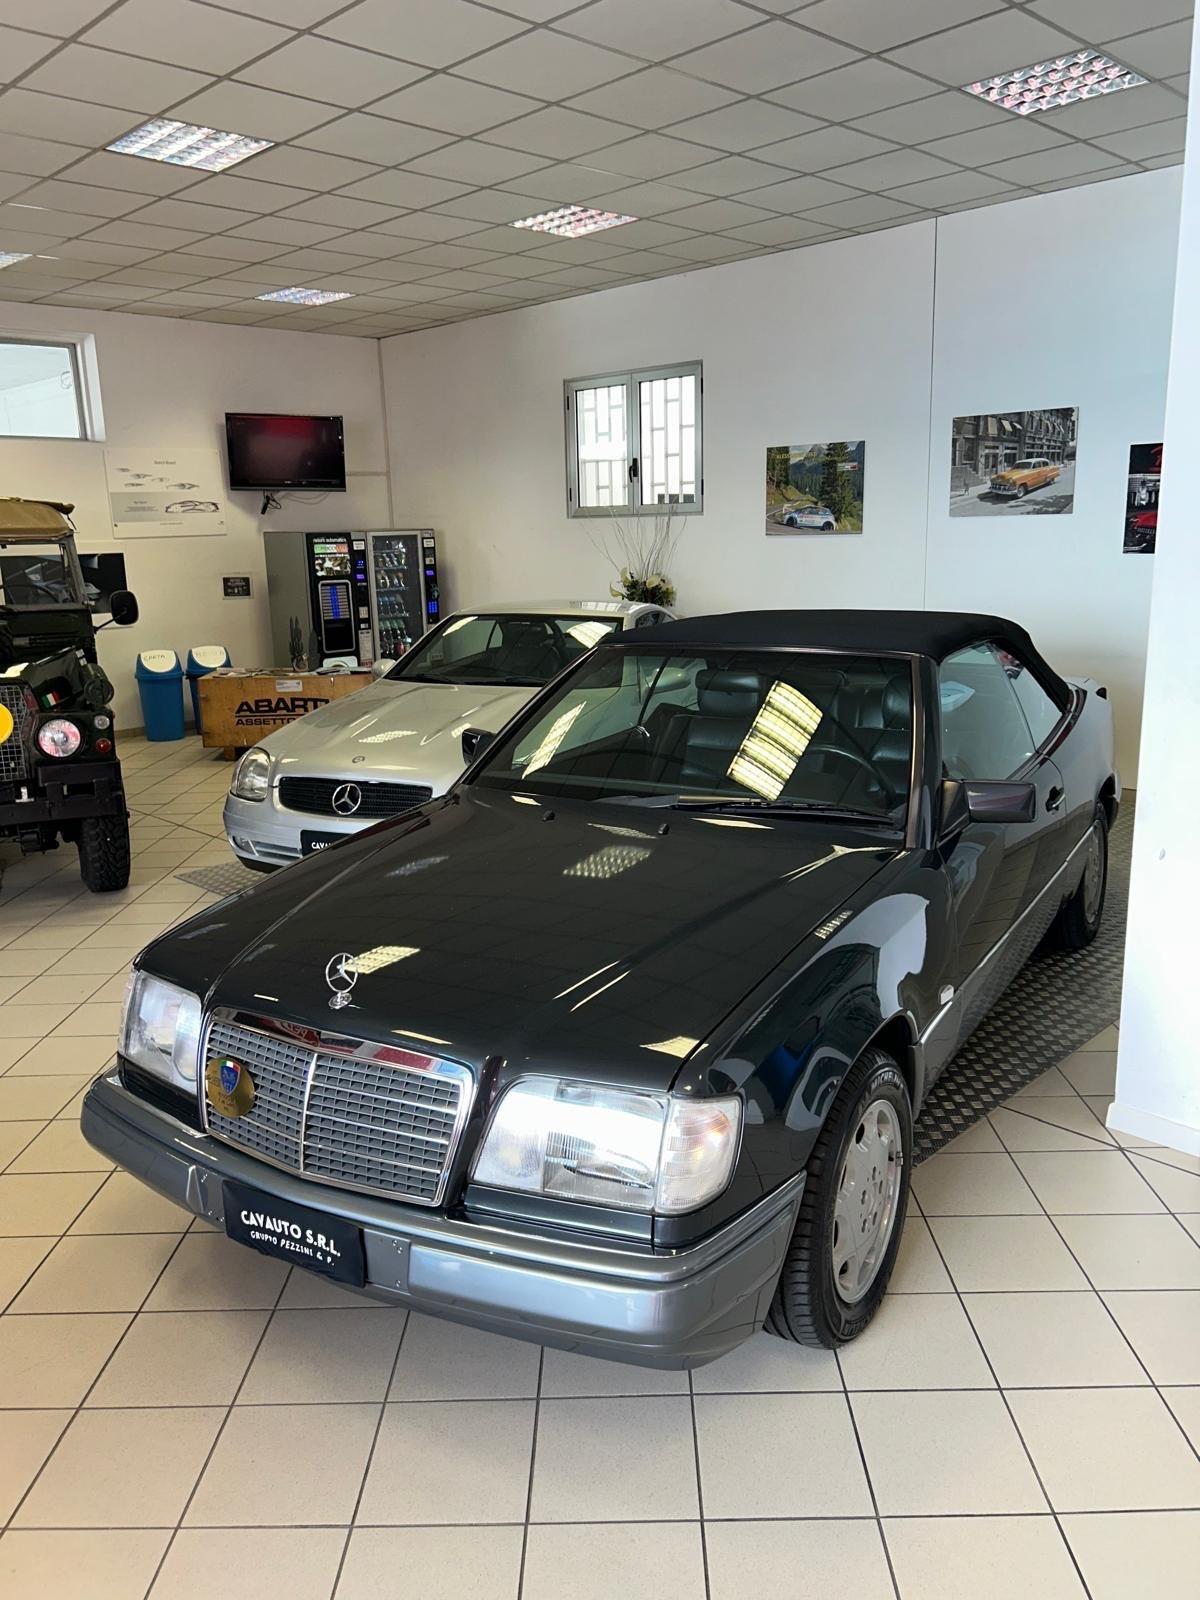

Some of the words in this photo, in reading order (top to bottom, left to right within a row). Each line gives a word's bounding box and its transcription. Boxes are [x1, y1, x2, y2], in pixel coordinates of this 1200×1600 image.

[240, 1210, 302, 1239] CAVAUTO
[305, 1229, 341, 1257] S.R.L.
[280, 1238, 313, 1257] PEZZINI
